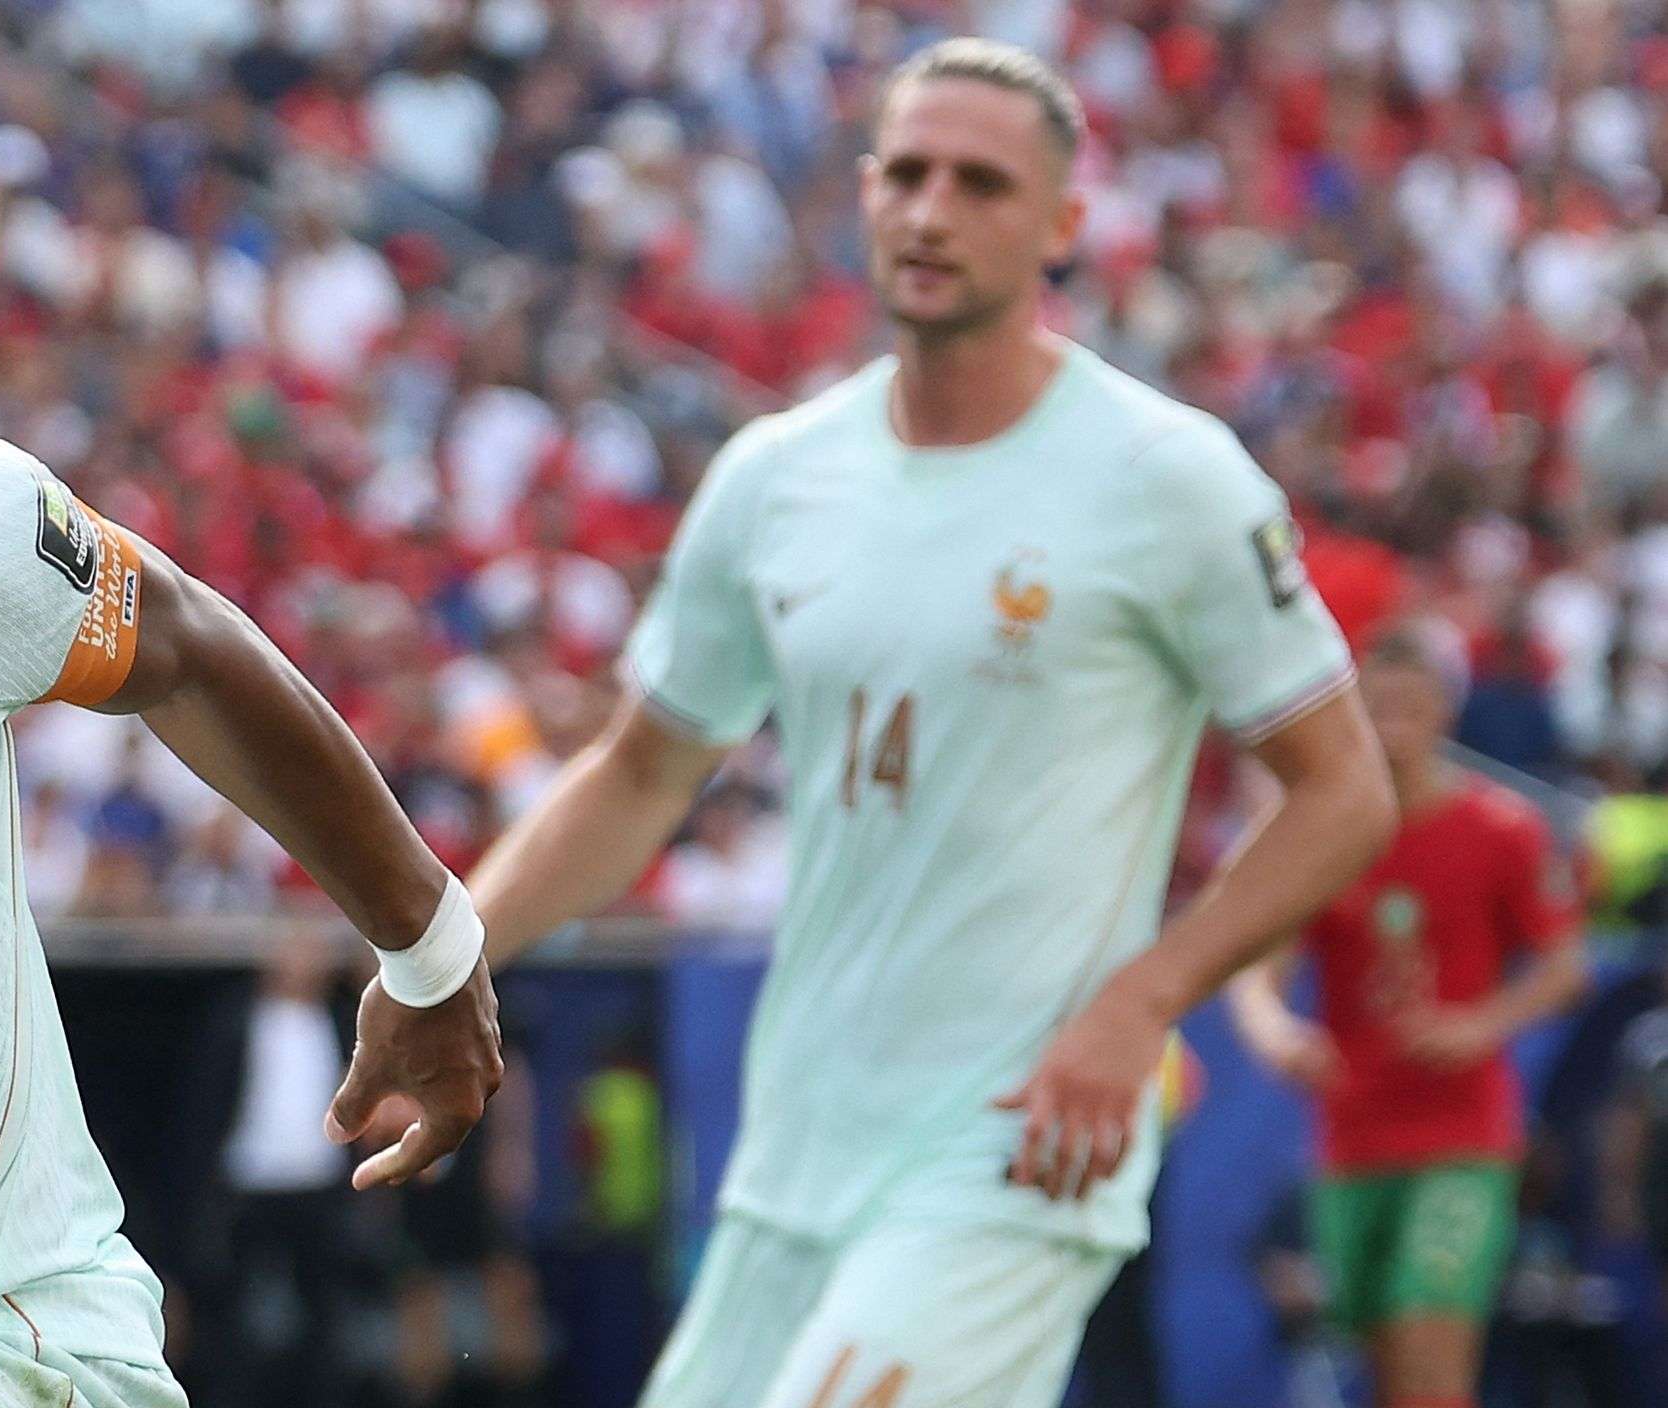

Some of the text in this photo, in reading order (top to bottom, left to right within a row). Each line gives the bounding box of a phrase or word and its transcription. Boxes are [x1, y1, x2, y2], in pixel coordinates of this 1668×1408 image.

[103, 529, 123, 608] Worl
[124, 574, 136, 622] FIFA
[839, 684, 916, 811] 14
